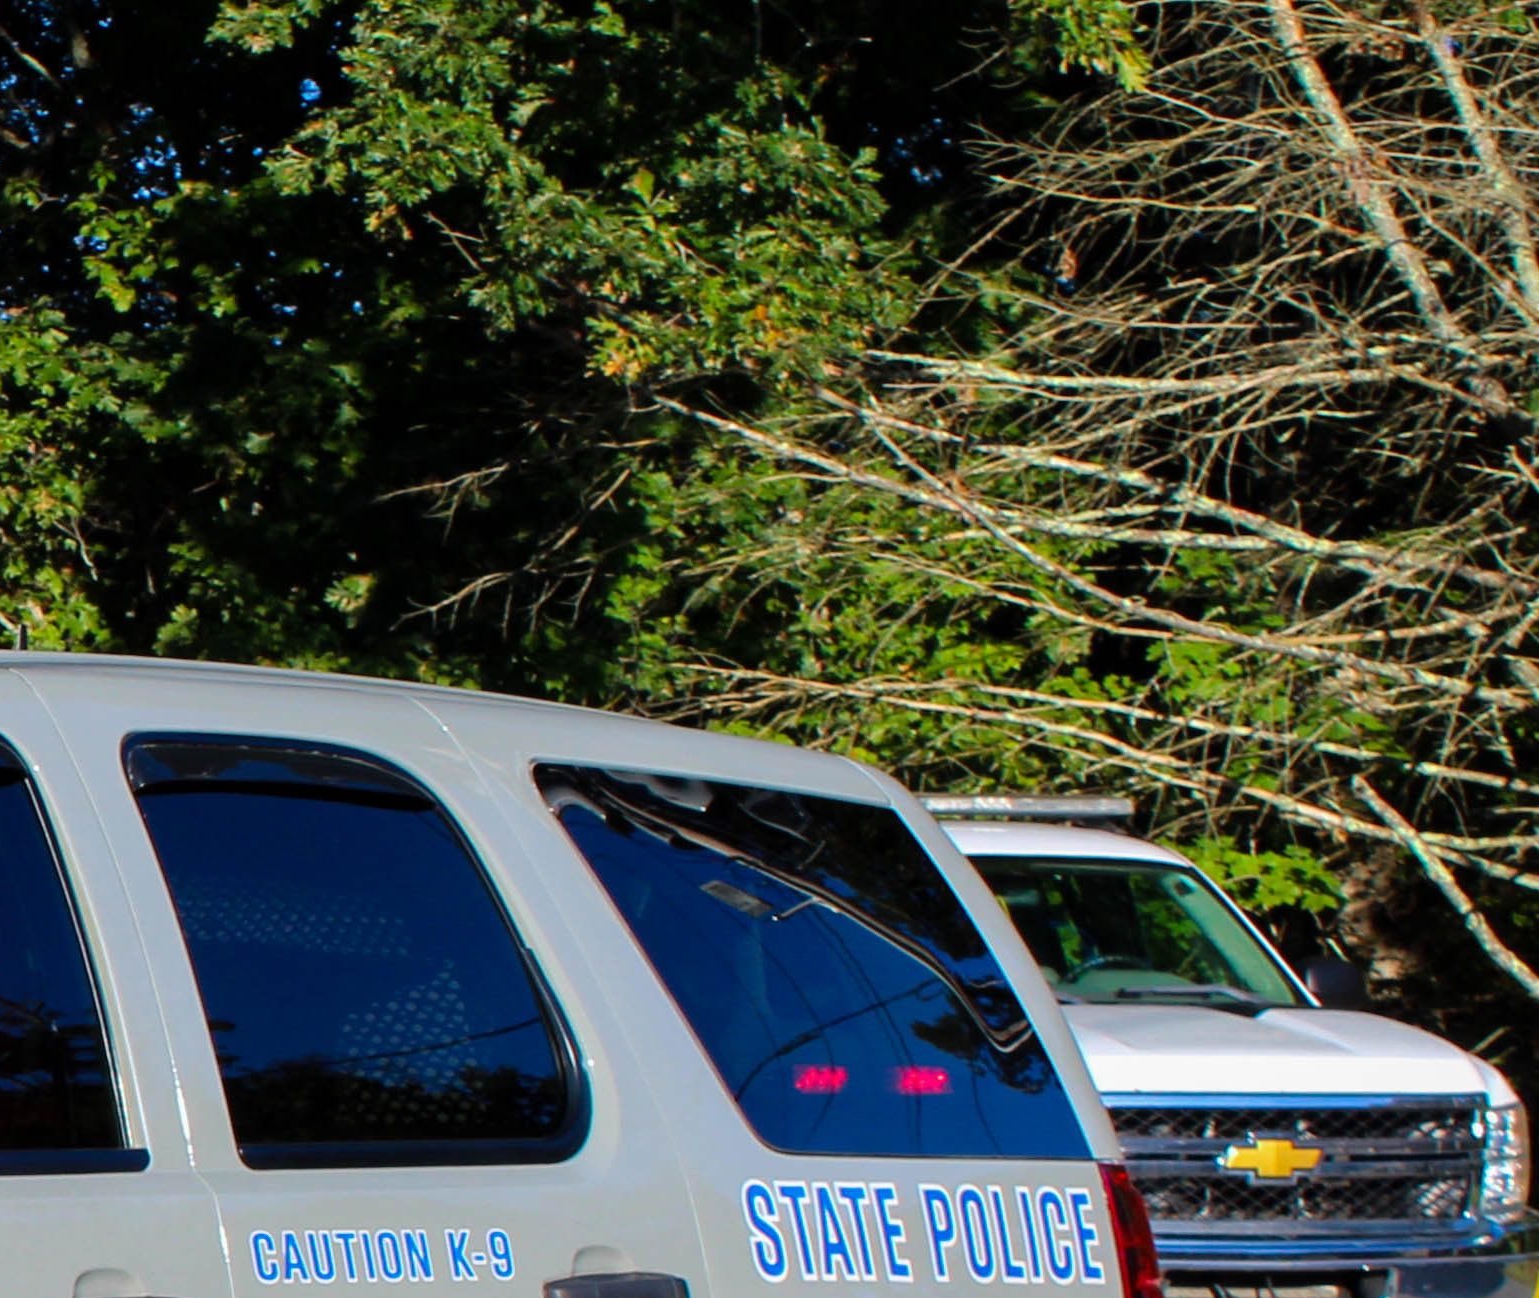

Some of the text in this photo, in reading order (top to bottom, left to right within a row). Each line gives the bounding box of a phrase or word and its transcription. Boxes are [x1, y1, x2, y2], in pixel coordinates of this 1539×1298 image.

[249, 1228, 515, 1284] CAUTION K-9
[741, 1178, 1105, 1285] STATE POLICE
